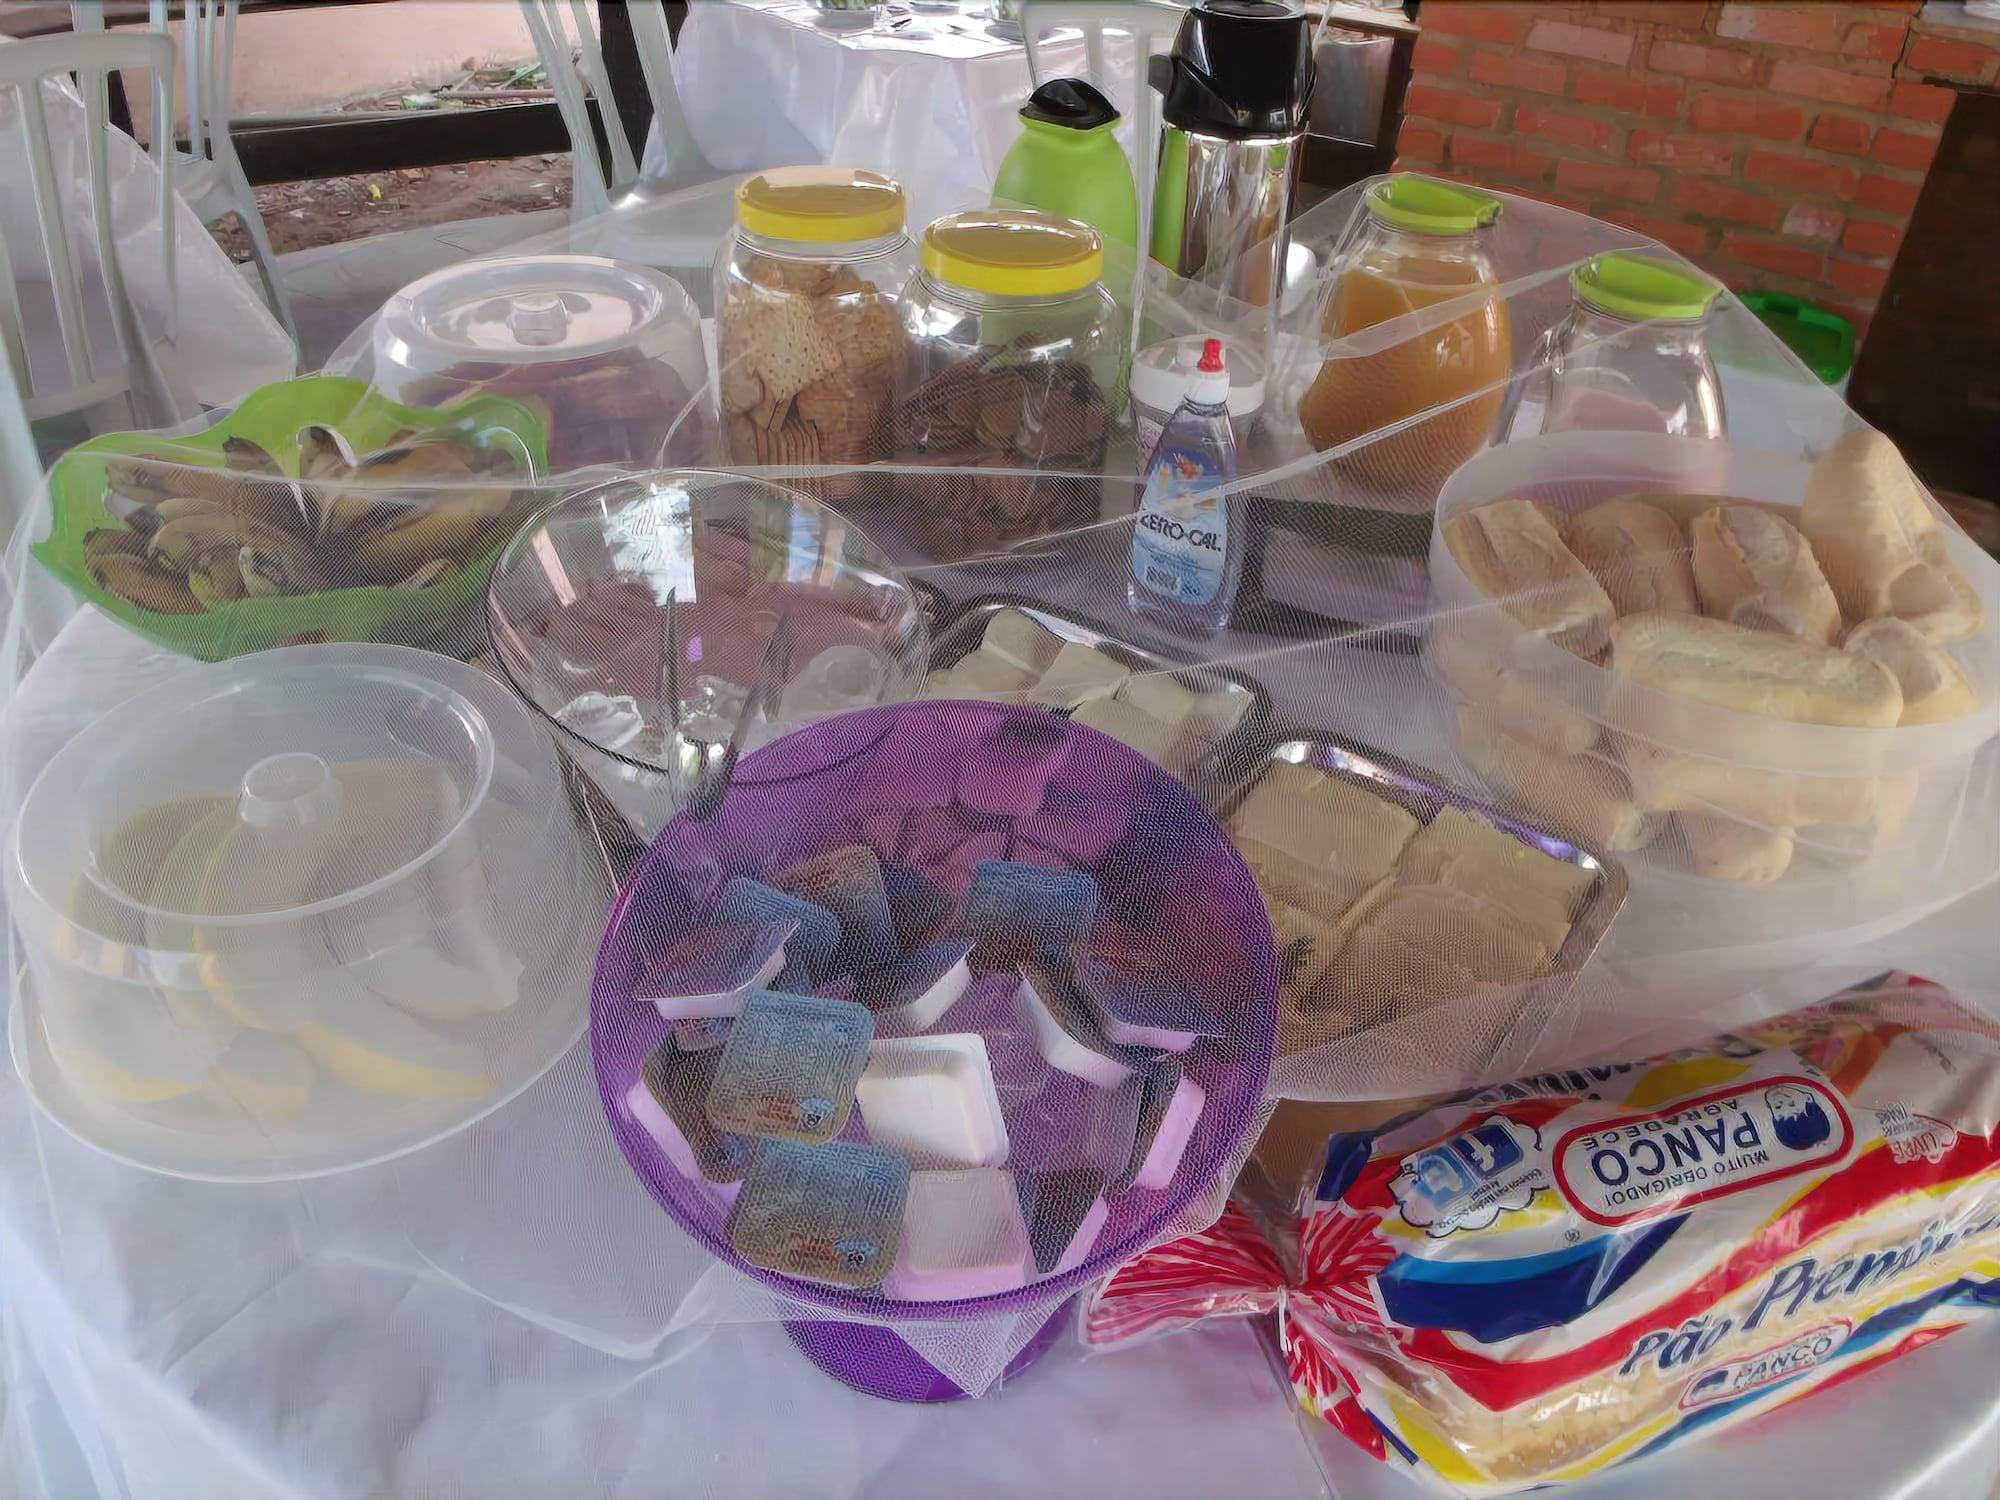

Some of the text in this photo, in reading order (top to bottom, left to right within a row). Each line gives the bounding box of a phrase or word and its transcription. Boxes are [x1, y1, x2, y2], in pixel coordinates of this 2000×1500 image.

[1579, 1099, 1739, 1150] AGRADECE
[1591, 1111, 1763, 1186] PANCO
[1604, 1149, 1769, 1207] MUITO OBRIGADO!
[1618, 1314, 1733, 1377] Pão
